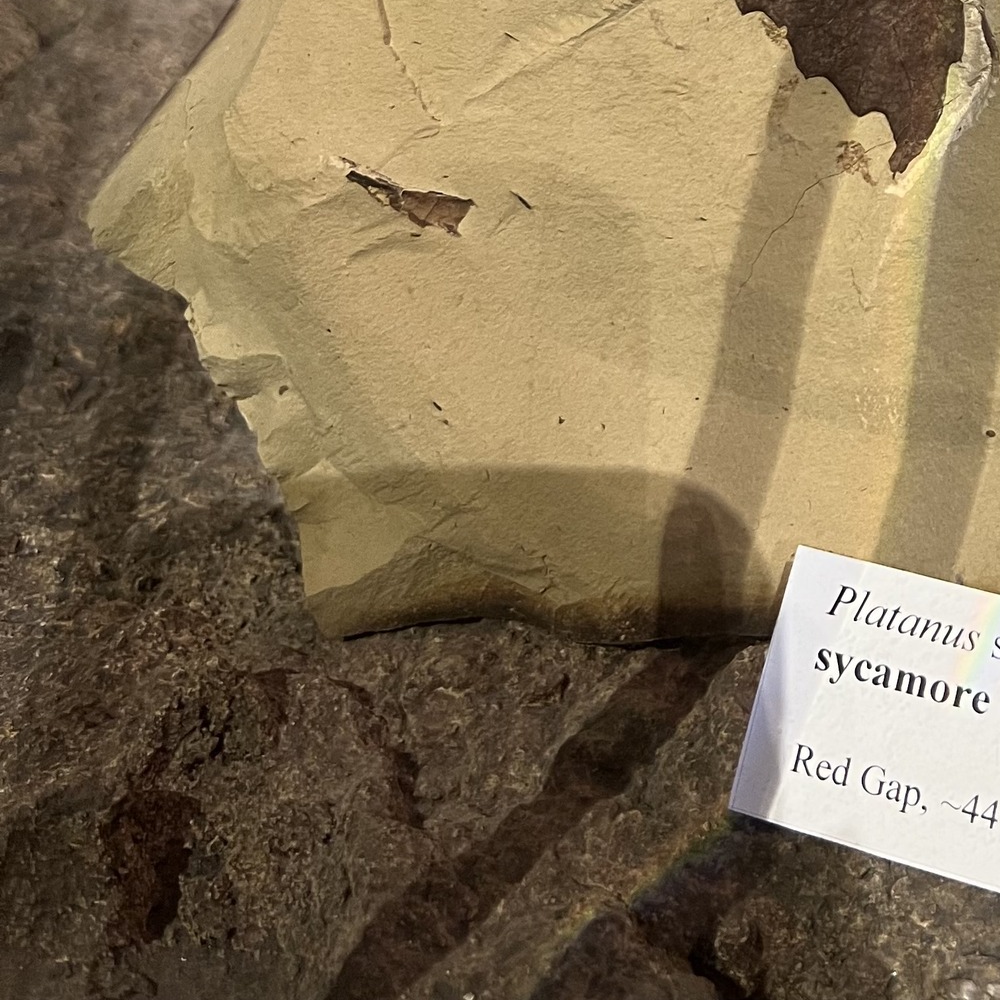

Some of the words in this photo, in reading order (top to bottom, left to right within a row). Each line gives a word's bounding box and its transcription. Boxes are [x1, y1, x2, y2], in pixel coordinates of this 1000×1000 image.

[825, 584, 982, 654] Platanus
[813, 646, 991, 716] sycamore
[790, 742, 852, 788] Red
[859, 763, 929, 816] Gap,
[939, 793, 999, 831] ~44
